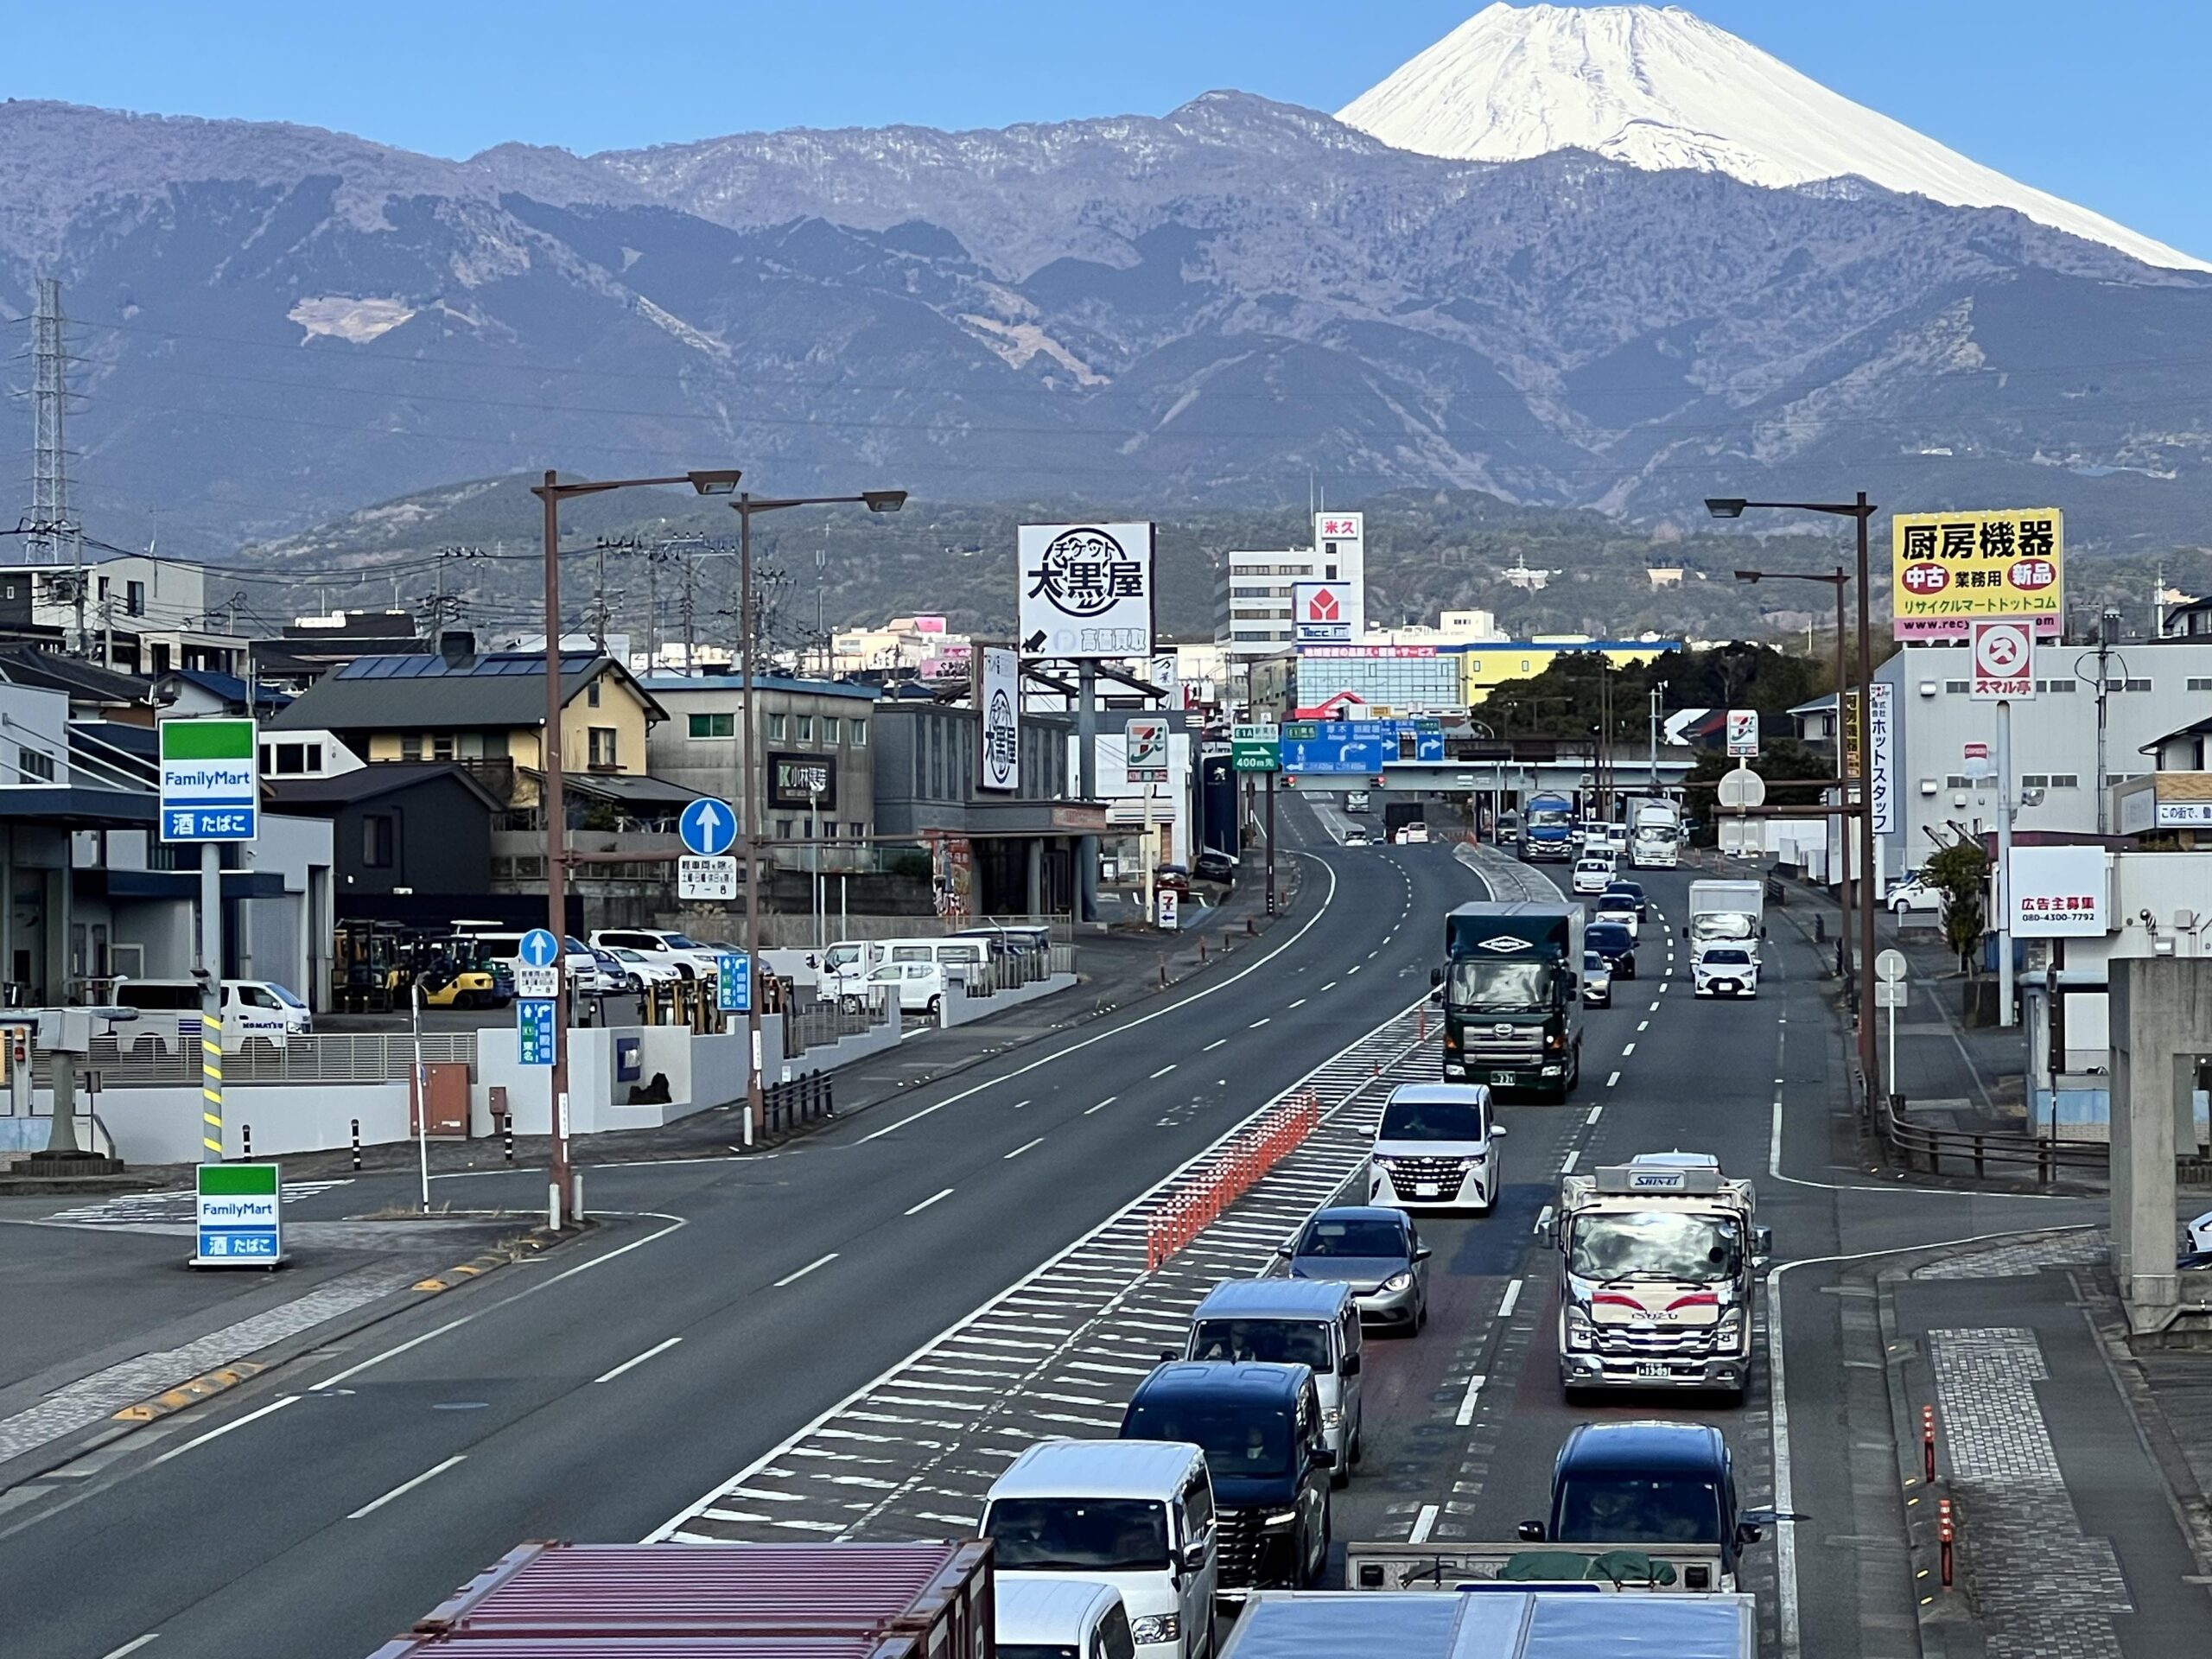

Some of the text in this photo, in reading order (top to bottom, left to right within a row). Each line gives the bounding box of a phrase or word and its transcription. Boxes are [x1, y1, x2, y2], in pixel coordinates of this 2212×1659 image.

[1325, 521, 1354, 534] 米久
[1903, 520, 2054, 560] 厨房機器
[1054, 542, 1116, 557] チケット
[1027, 562, 1143, 599] 大黒屋
[1906, 563, 2052, 588] 中古 業務用 新品
[1904, 596, 2056, 614] リサイクルマートドットコム
[1975, 681, 2031, 696] スマル亭
[1236, 728, 1253, 737] E1A
[165, 771, 250, 789] FamilyMart
[1872, 719, 1886, 830] ホットスタッフ
[173, 813, 246, 835] 酒 たばこ
[2021, 897, 2094, 910] 広告主募集
[203, 1203, 272, 1217] FamilyMart
[209, 1236, 270, 1255] 酒 たばこ
